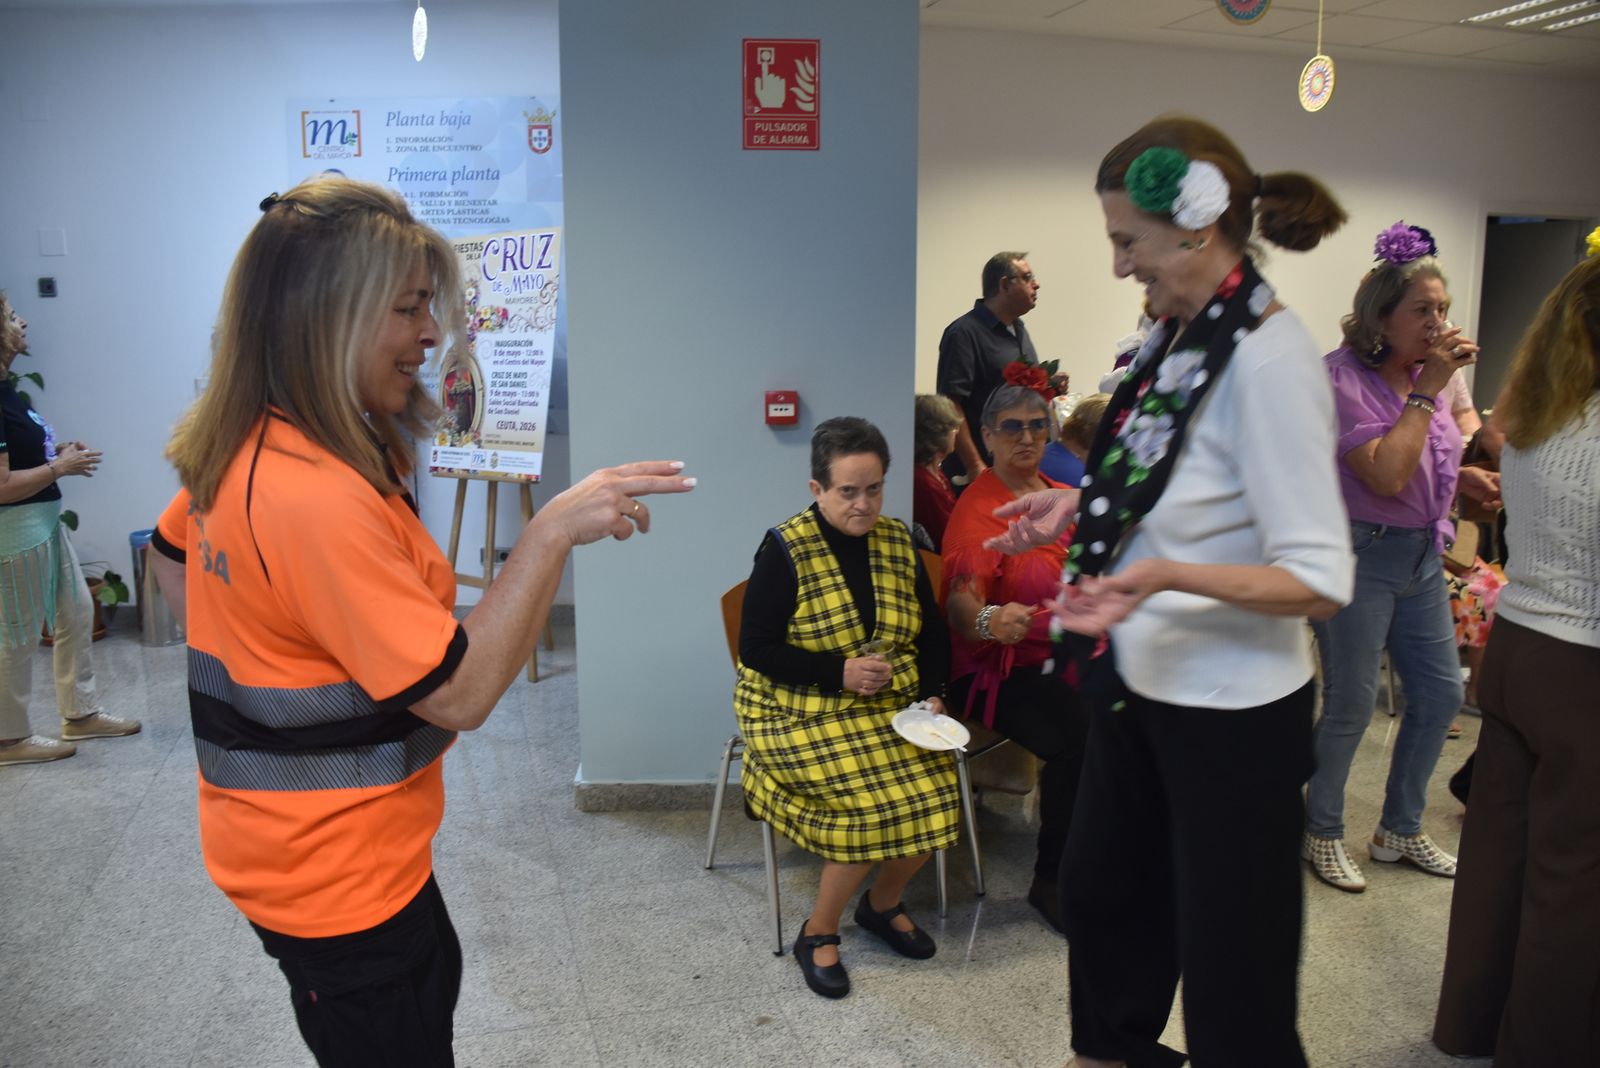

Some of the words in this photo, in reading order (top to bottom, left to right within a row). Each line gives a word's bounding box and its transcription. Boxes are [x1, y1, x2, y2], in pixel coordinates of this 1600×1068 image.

[386, 111, 435, 127] Planta
[440, 110, 471, 130] baja
[755, 123, 808, 132] PULSADOR
[753, 135, 766, 144] DE
[769, 135, 809, 144] ALARMA
[432, 144, 482, 152] ENCUENTRO
[388, 167, 447, 182] Primera
[451, 165, 500, 185] planta
[454, 242, 484, 254] FIESTAS
[475, 252, 481, 260] LA
[483, 234, 554, 281] CRUZ
[492, 281, 502, 292] DE
[505, 274, 545, 296] MAYO
[506, 350, 521, 358] mayo
[491, 371, 505, 379] CRUZ
[513, 371, 528, 379] MAYO
[496, 421, 518, 431] CEUTA,
[520, 422, 536, 432] 2026
